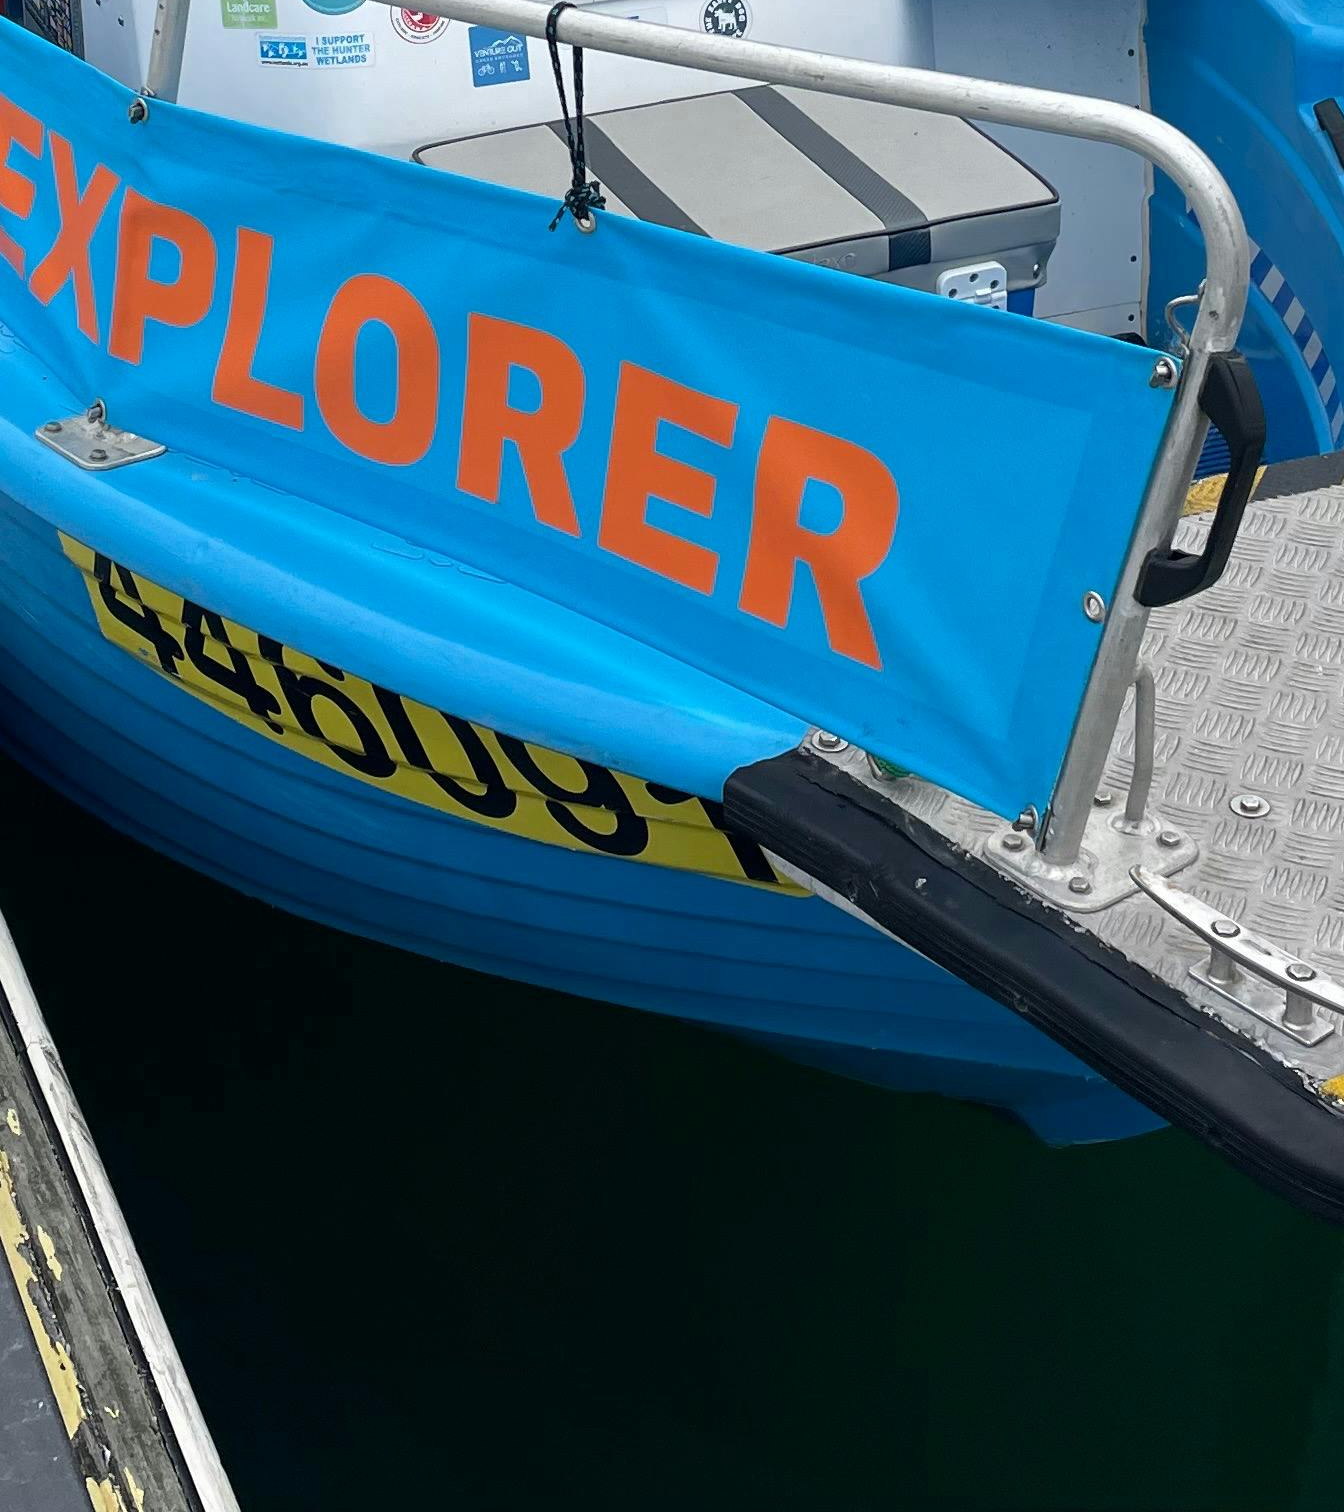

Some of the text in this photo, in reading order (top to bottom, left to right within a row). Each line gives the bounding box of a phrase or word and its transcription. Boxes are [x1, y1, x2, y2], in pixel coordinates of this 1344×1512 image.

[227, 1, 272, 14] Landcare
[322, 34, 365, 45] SUPPORT
[312, 44, 371, 56] THE HUNTER
[506, 42, 524, 54] OUT
[316, 55, 367, 66] WETLANDS
